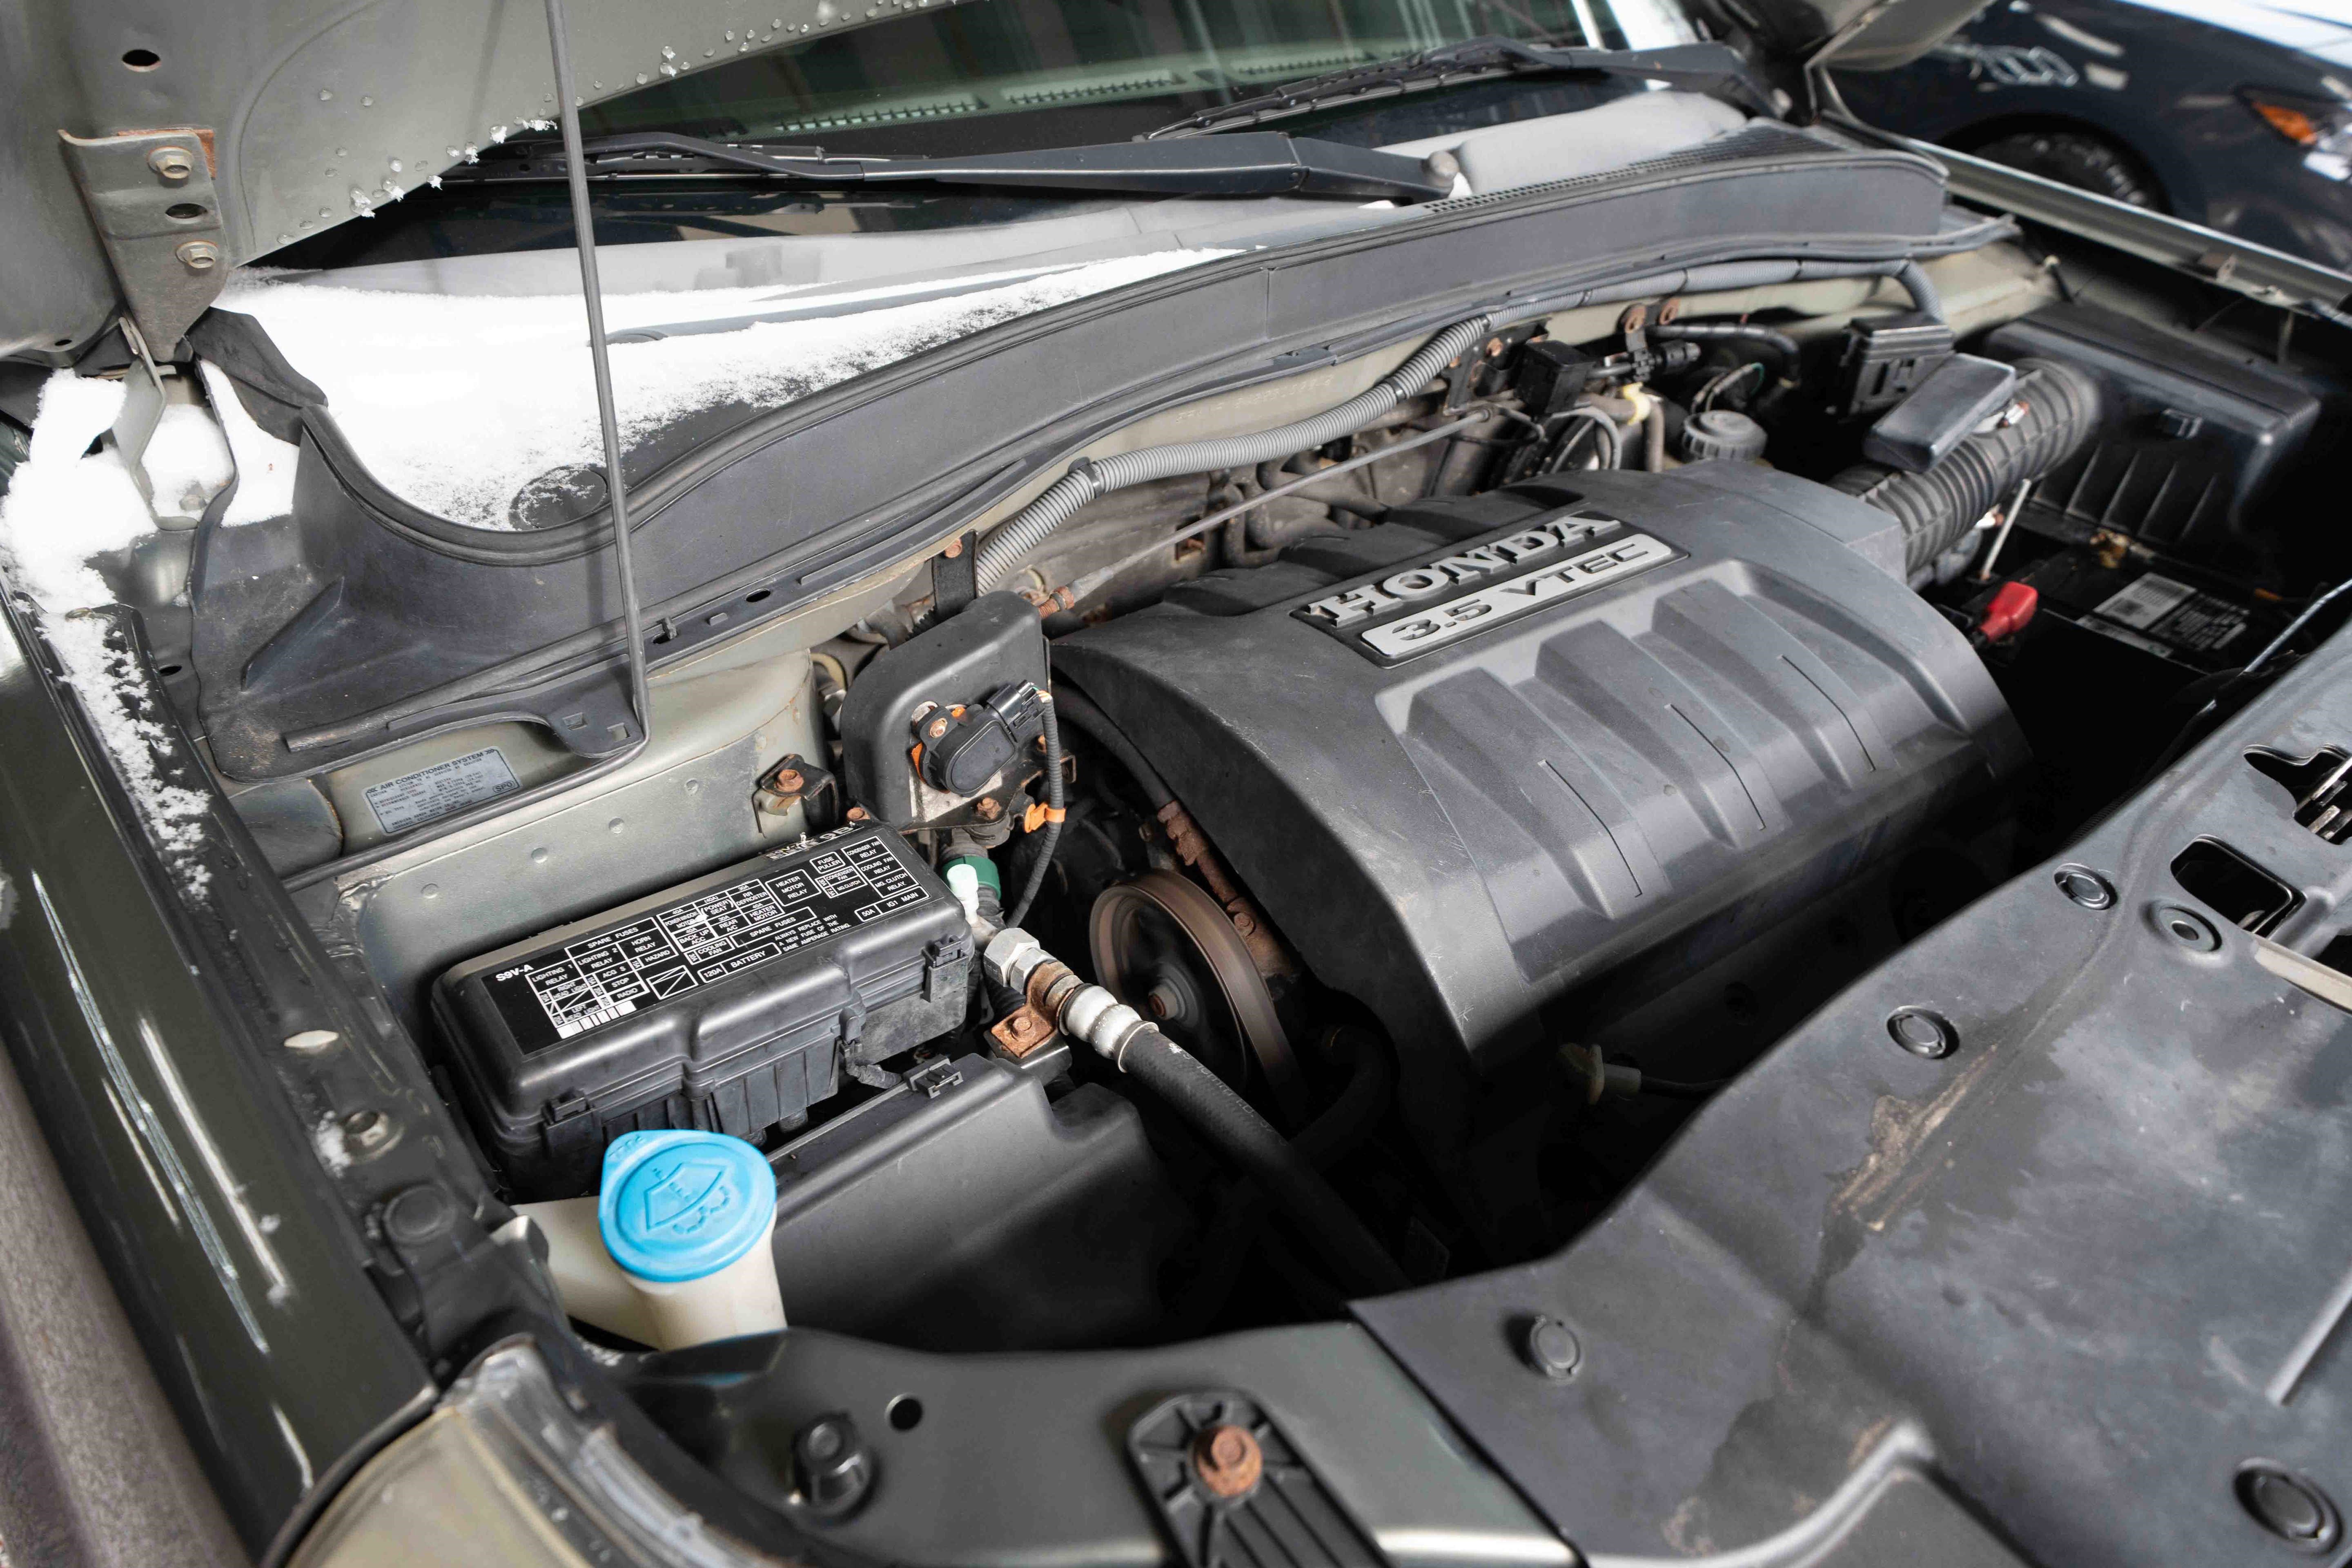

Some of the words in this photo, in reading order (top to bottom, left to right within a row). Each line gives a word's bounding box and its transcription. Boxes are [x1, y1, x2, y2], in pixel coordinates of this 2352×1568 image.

[1308, 515, 1621, 628] HONDA
[1392, 599, 1492, 641] 3.5
[1499, 542, 1649, 596] VTEC
[381, 782, 394, 791] AIR
[395, 763, 451, 784] CONDITIONER
[452, 752, 484, 766] SYSTEM
[846, 844, 871, 856] CONDENSER
[860, 849, 877, 858] RELAY
[817, 856, 835, 865] FUSE
[817, 860, 841, 871] PULLER
[860, 861, 882, 871] COOLING
[826, 868, 853, 881] CONDENSER
[873, 865, 891, 874] RELAY
[775, 876, 801, 888] HEATER
[886, 872, 908, 884] CLUTCH
[781, 882, 805, 893] MOTOR
[887, 881, 905, 891] RELAY
[736, 891, 768, 906] DEFROSTER
[787, 889, 808, 899] RELAY
[901, 892, 919, 902] MAIN
[749, 905, 775, 917] HEATER
[753, 910, 778, 921] MOTOR
[719, 919, 738, 929] REAR
[750, 926, 773, 937] SPARE
[774, 917, 796, 928] FUSES
[775, 929, 796, 940] ALWAYS
[797, 920, 822, 931] REPLACE
[800, 929, 816, 938] FUSE
[587, 936, 612, 948] SPARE
[615, 927, 639, 938] FUSES
[631, 935, 652, 946] HORN
[678, 933, 698, 944] BACK
[691, 937, 706, 945] ACC
[782, 943, 799, 951] SAME
[800, 931, 830, 945] AMPERAGE
[830, 923, 852, 933] RATING.
[634, 942, 656, 953] RELAY
[697, 941, 727, 954] COOLING
[708, 948, 723, 956] FAN
[577, 951, 610, 966] LIGHTING
[644, 950, 671, 962] HAZARD
[590, 957, 613, 969] RELAY
[703, 968, 723, 978] 120A
[730, 950, 766, 968] BATTERY
[495, 964, 534, 982] S9V-A
[532, 967, 566, 982] LIGHTING
[602, 969, 617, 978] ACG
[545, 974, 568, 986] RELAY
[611, 978, 630, 988] STOP
[557, 982, 576, 992] RIGHT
[571, 983, 588, 993] LIGHT
[616, 988, 638, 999] RADIO
[572, 1004, 587, 1013] LEFT
[584, 1004, 601, 1015] LIGHT
